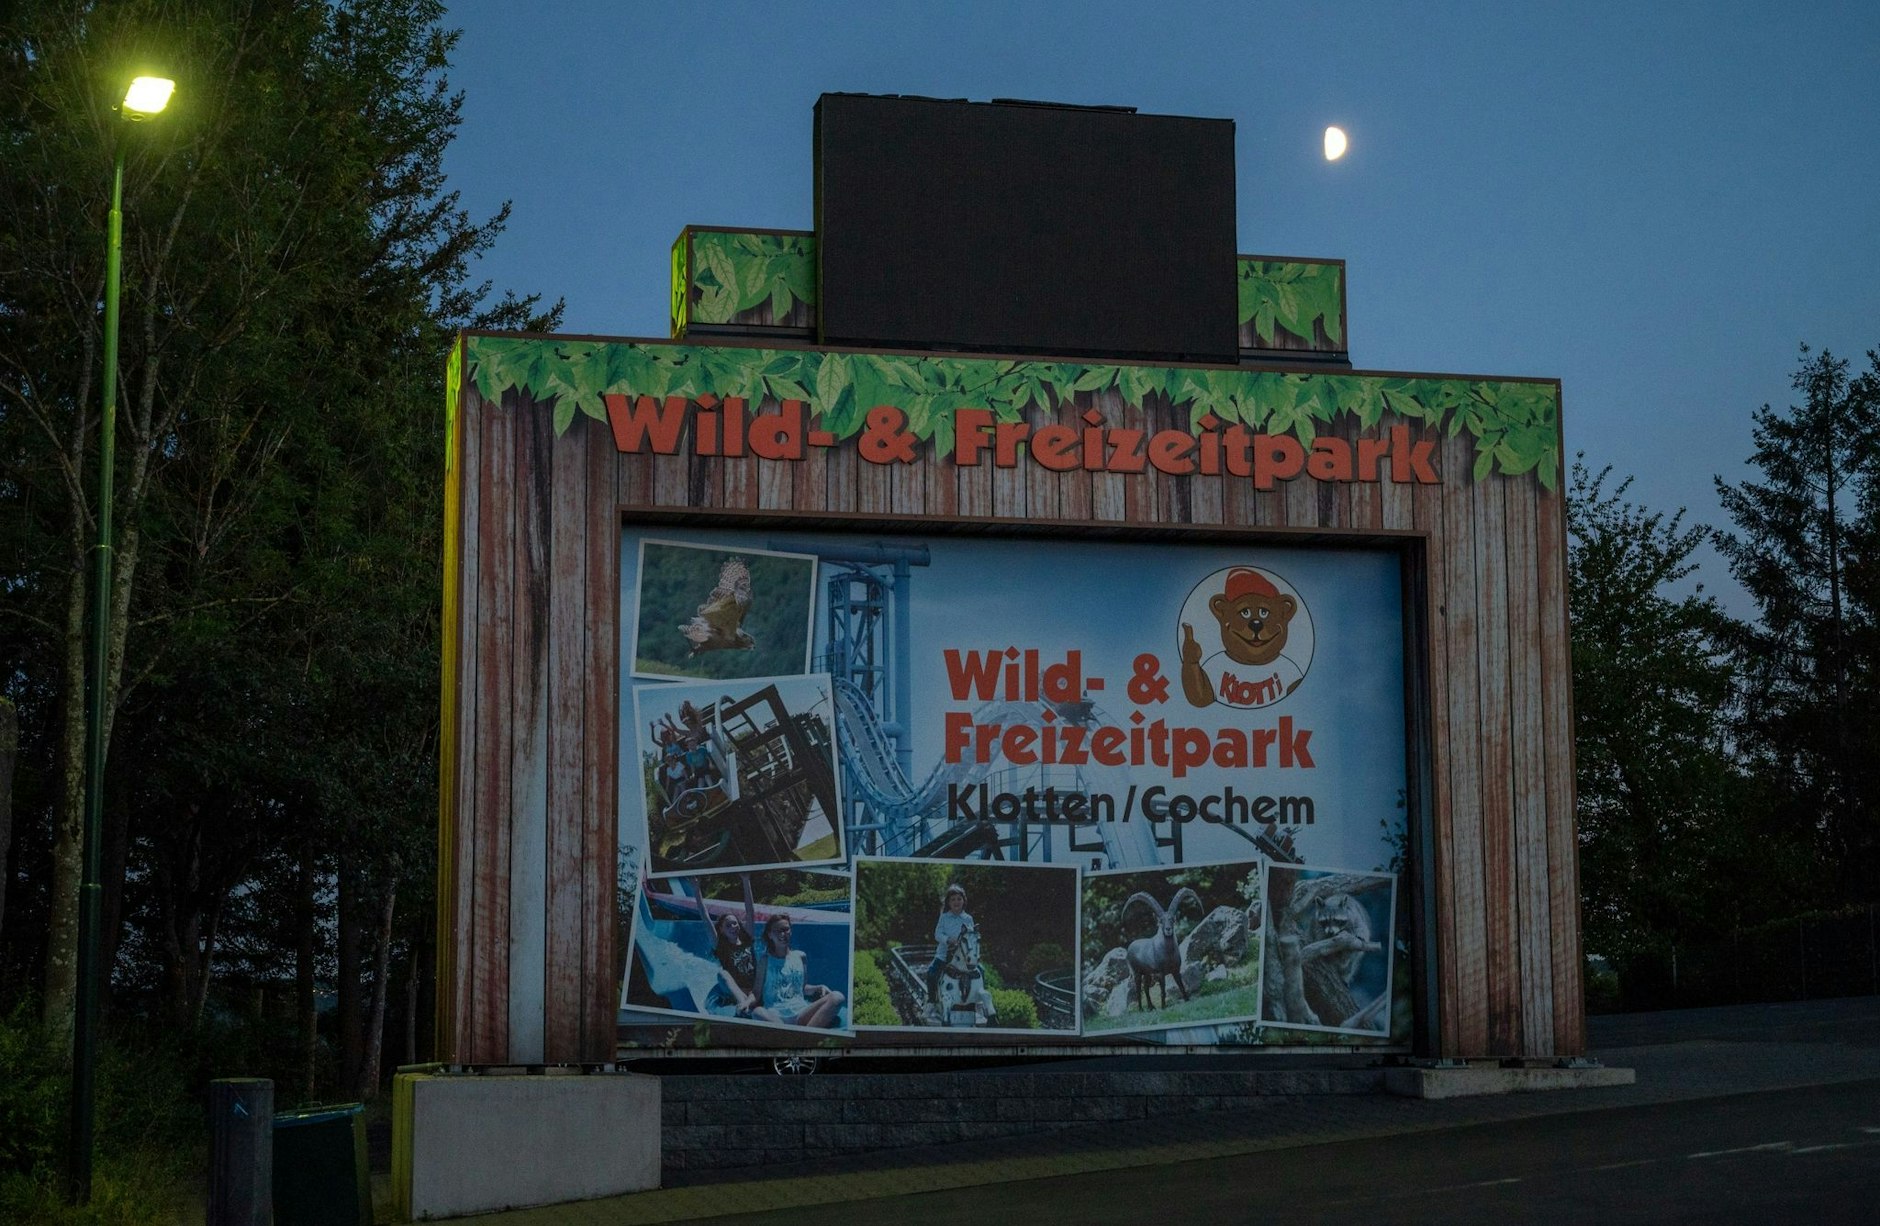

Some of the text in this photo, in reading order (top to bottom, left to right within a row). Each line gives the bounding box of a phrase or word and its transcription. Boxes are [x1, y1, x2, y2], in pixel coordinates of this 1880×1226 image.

[605, 393, 1442, 492] Wild- & Freizeitpark
[943, 647, 1170, 705] Wild- &
[945, 710, 1316, 778] Freizeitpark
